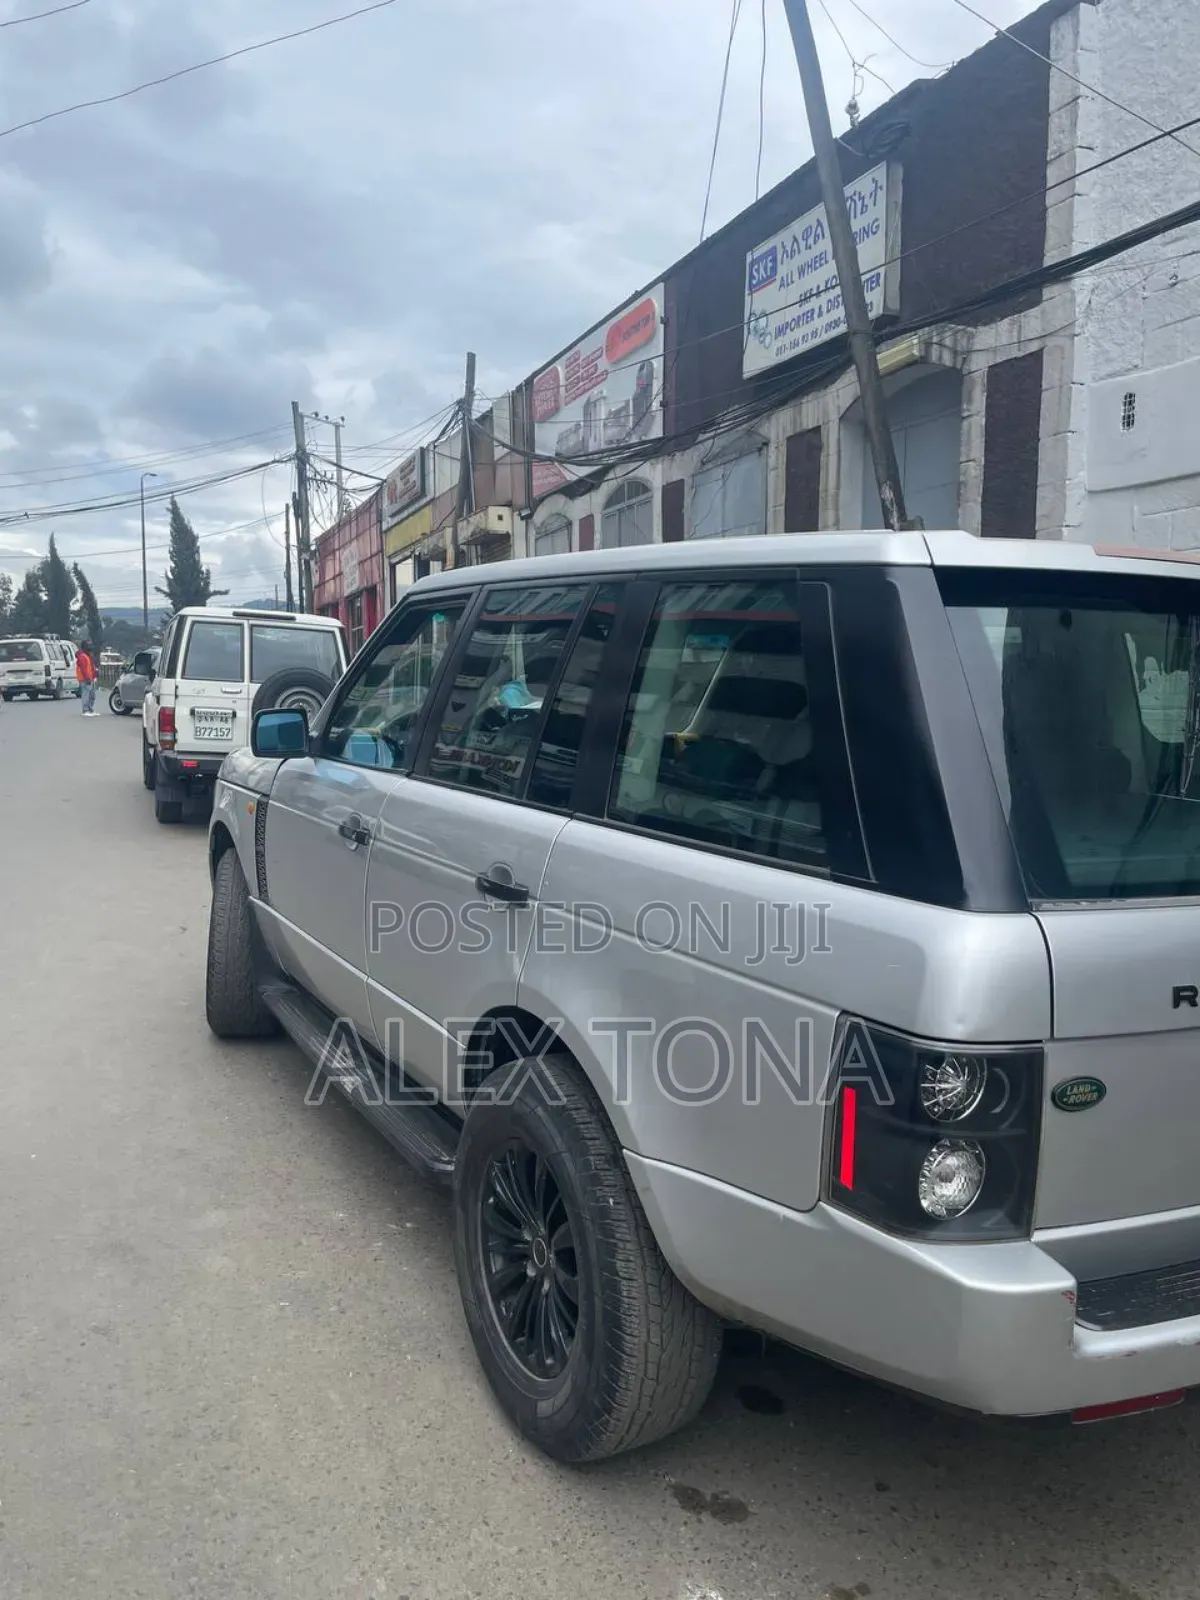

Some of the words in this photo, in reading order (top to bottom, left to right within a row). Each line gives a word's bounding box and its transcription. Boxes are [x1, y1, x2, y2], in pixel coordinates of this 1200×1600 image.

[752, 256, 773, 285] SKF
[778, 271, 795, 292] ALL
[797, 249, 829, 280] WHEEL
[774, 308, 815, 340] IMPORTER
[818, 303, 824, 319] &
